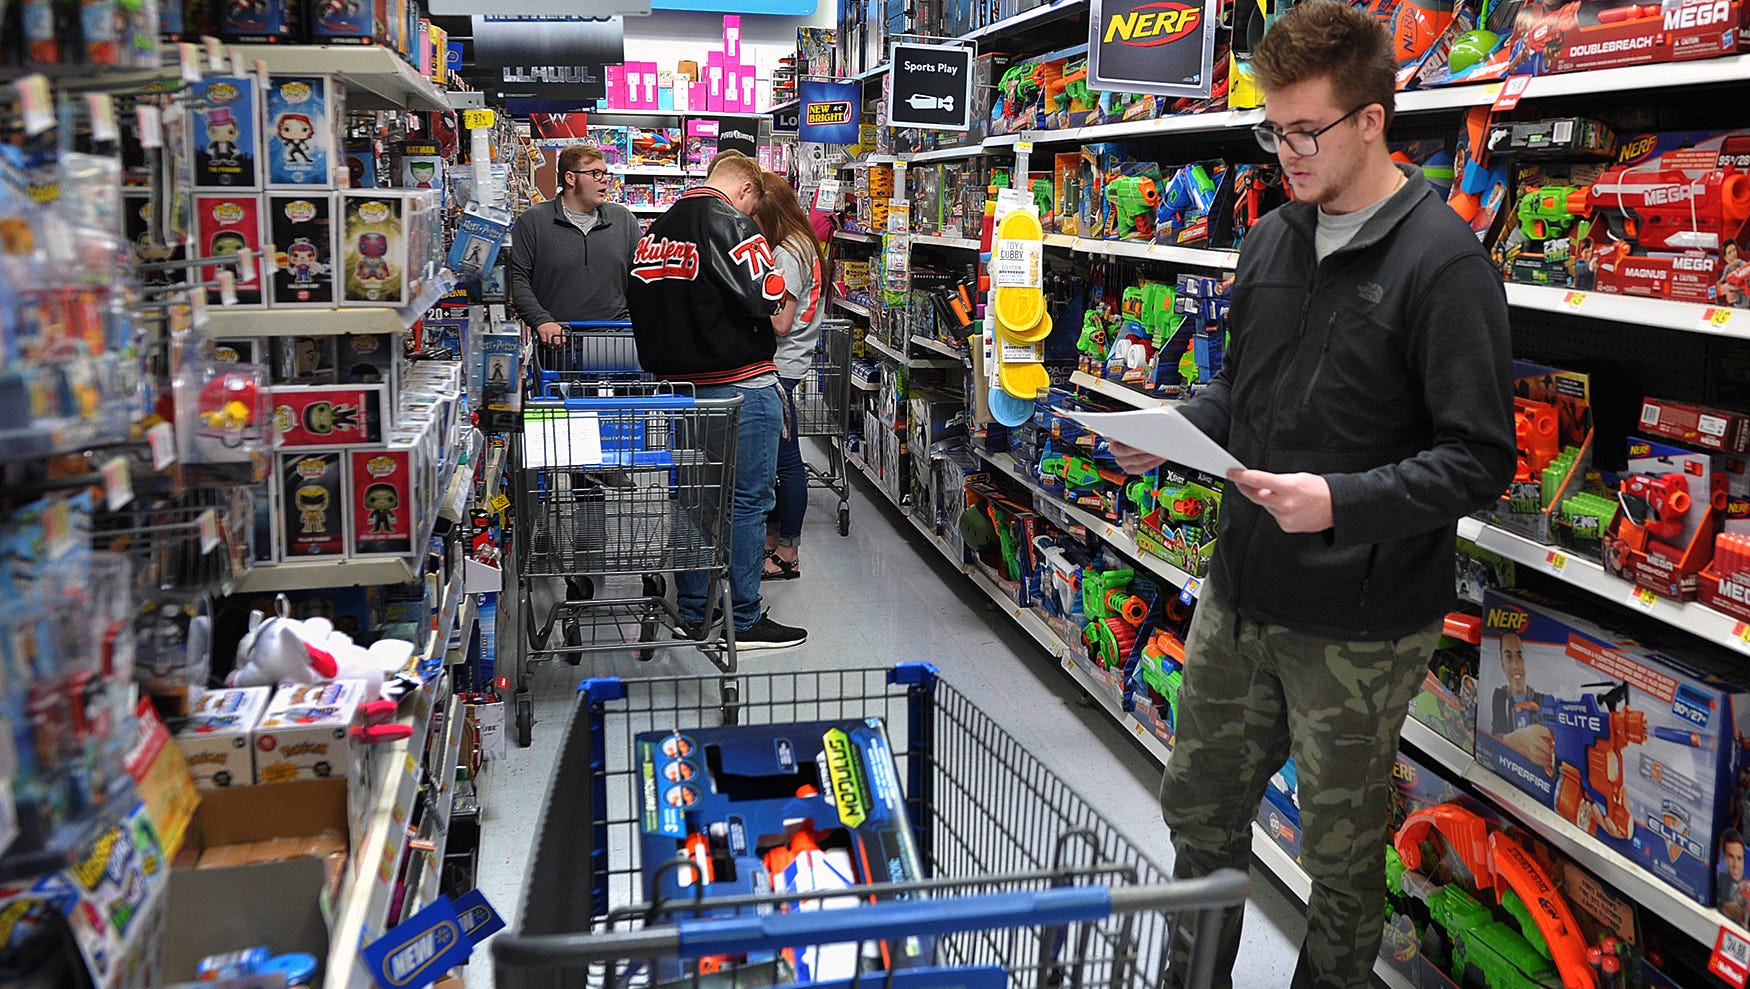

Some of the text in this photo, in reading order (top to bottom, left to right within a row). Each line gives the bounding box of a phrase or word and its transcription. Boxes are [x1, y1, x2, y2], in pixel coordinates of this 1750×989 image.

[1103, 7, 1200, 44] NERF
[1663, 1, 1730, 31] MEGA
[1569, 36, 1653, 57] DOUBLEBREACH
[904, 61, 958, 76] Sports Play
[809, 105, 830, 115] NEW
[809, 112, 844, 123] BRIGHT
[779, 114, 800, 127] Lo
[1619, 135, 1657, 162] NERF
[1643, 185, 1692, 206] MEGA
[1000, 250, 1024, 259] CUBBY
[1006, 241, 1020, 250] TOY
[1624, 267, 1667, 280] MAGNUS
[1672, 257, 1714, 272] MEGA
[427, 308, 450, 320] 20+
[1629, 444, 1651, 456] NERF
[1510, 498, 1542, 514] STRIKE
[1727, 502, 1750, 514] NERF
[1487, 608, 1529, 629] NERF
[1557, 712, 1601, 732] ELITE
[828, 737, 861, 818] MODULUS
[1392, 761, 1417, 783] ERF
[1498, 754, 1551, 794] HYPERFIRE
[1651, 761, 1663, 781] 5
[1648, 817, 1702, 855] ELITE
[391, 931, 436, 977] NEW
